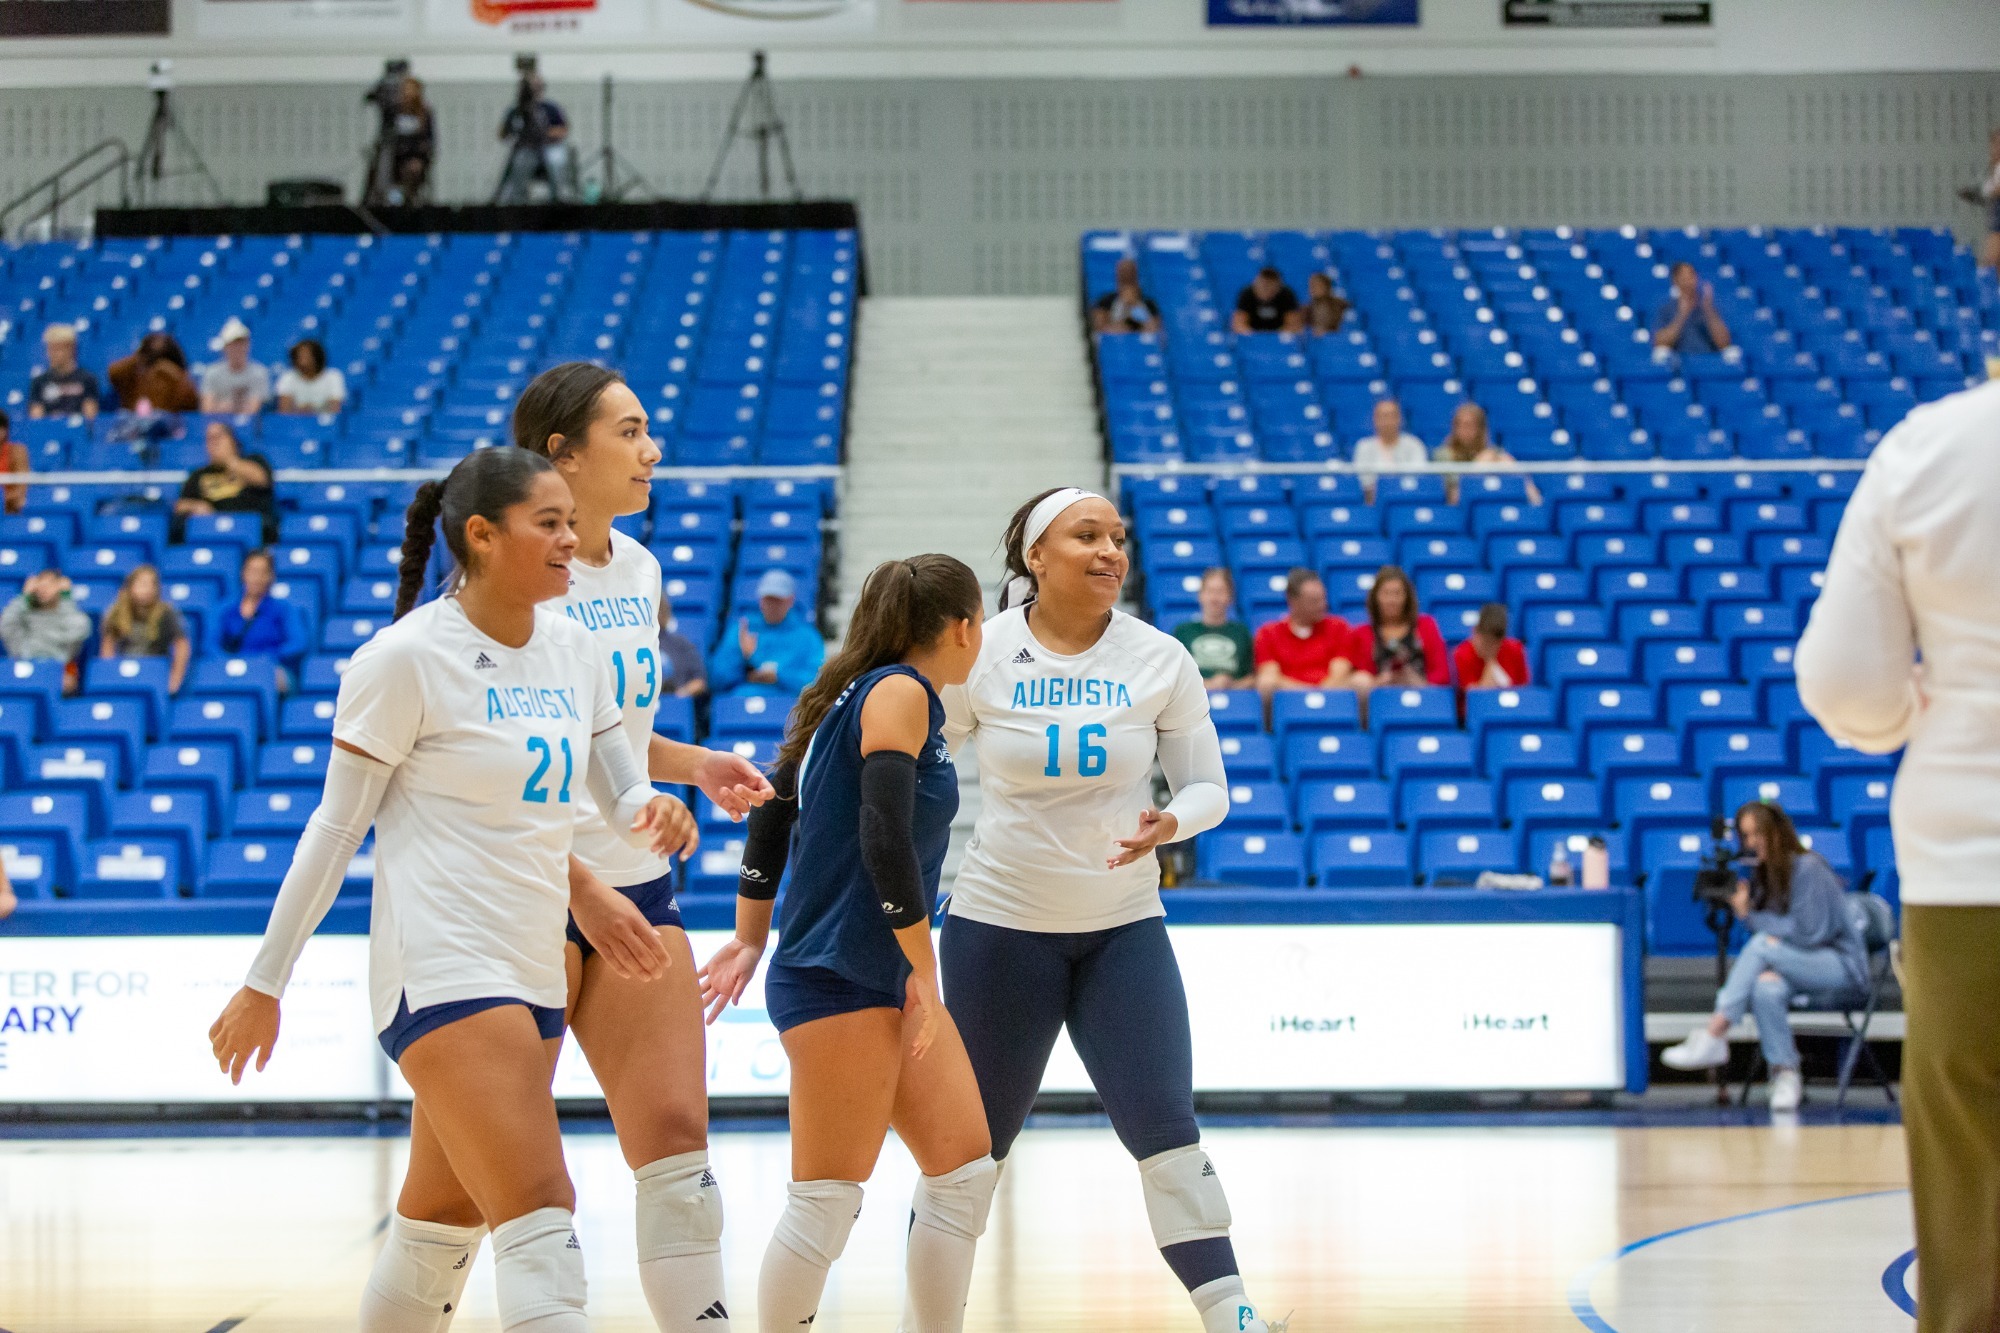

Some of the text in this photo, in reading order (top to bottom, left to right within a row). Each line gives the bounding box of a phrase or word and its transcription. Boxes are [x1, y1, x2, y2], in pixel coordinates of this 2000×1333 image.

[611, 647, 656, 709] 13
[1011, 677, 1132, 709] AUGUSTA
[1044, 723, 1107, 777] 16
[521, 736, 574, 803] 21
[0, 970, 57, 998] ER
[71, 970, 149, 998] FOR
[0, 1004, 83, 1033] ARY
[1270, 1014, 1356, 1032] iHeart
[1463, 1012, 1549, 1031] iHeart
